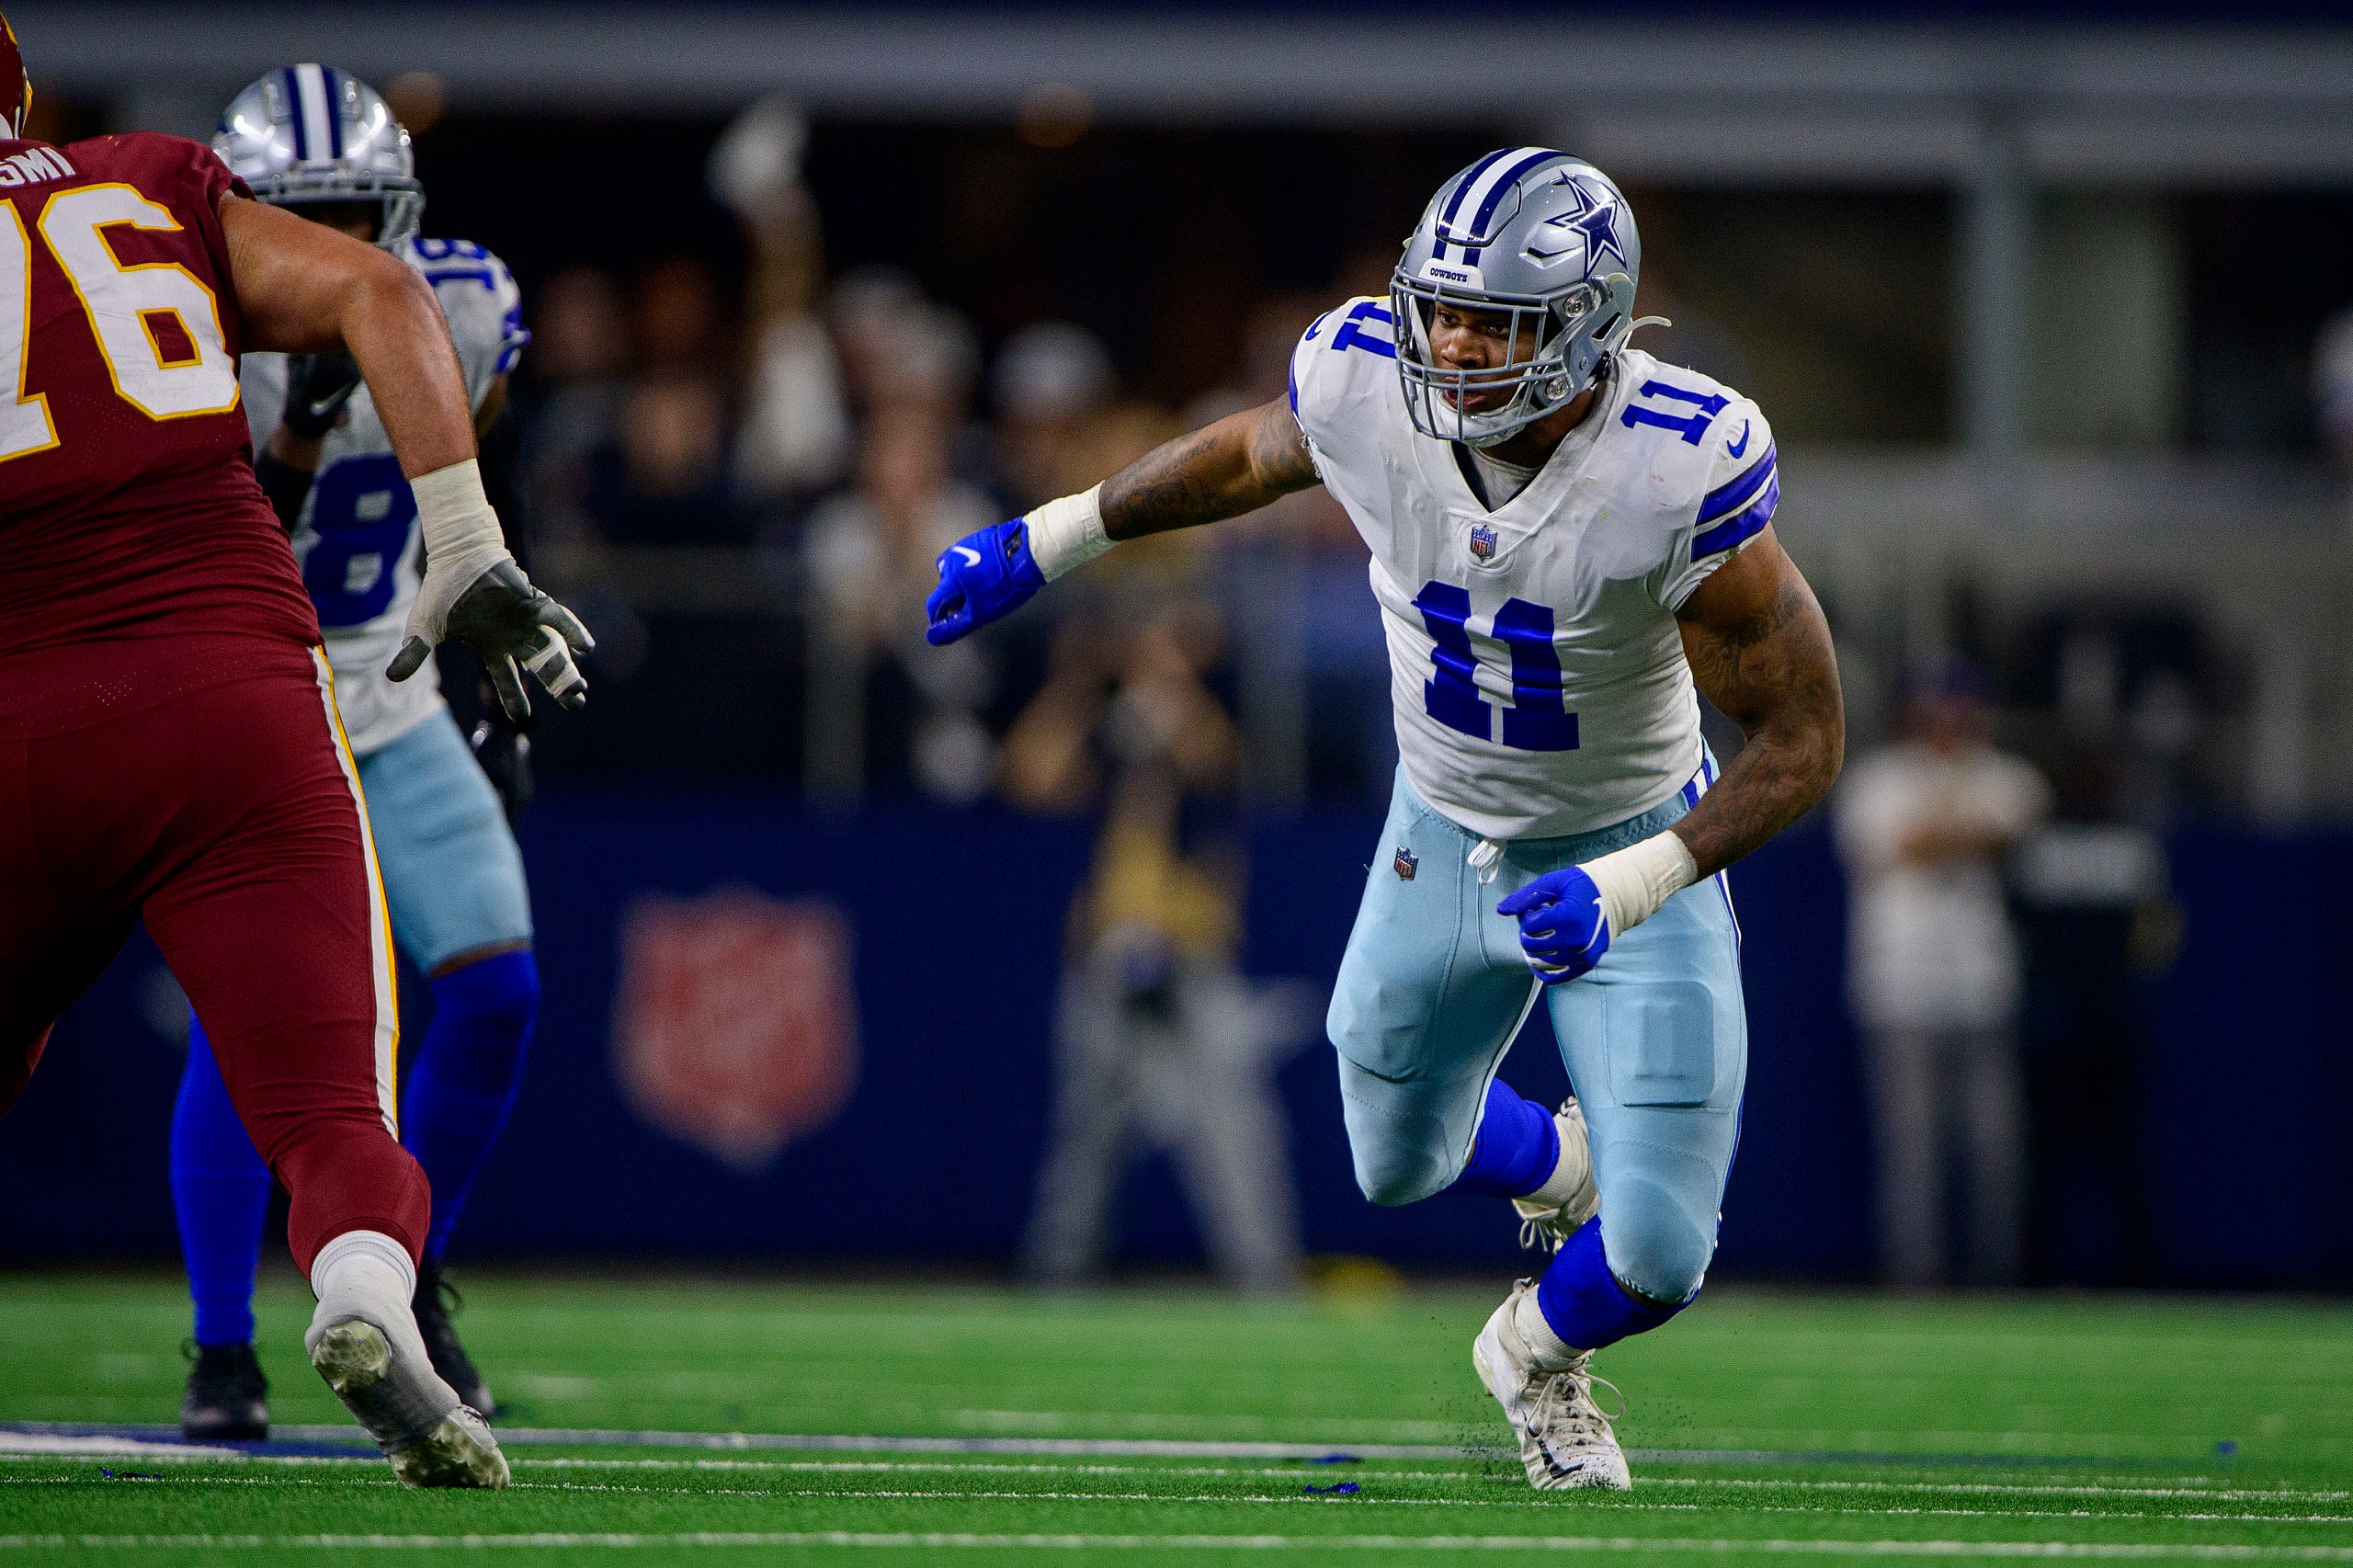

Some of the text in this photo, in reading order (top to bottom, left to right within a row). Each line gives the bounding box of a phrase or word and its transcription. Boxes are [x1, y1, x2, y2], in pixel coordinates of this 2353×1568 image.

[1429, 267, 1468, 282] COWBOYS
[1620, 379, 1731, 447] 11
[1472, 540, 1490, 555] NFL
[1411, 580, 1580, 752] 11
